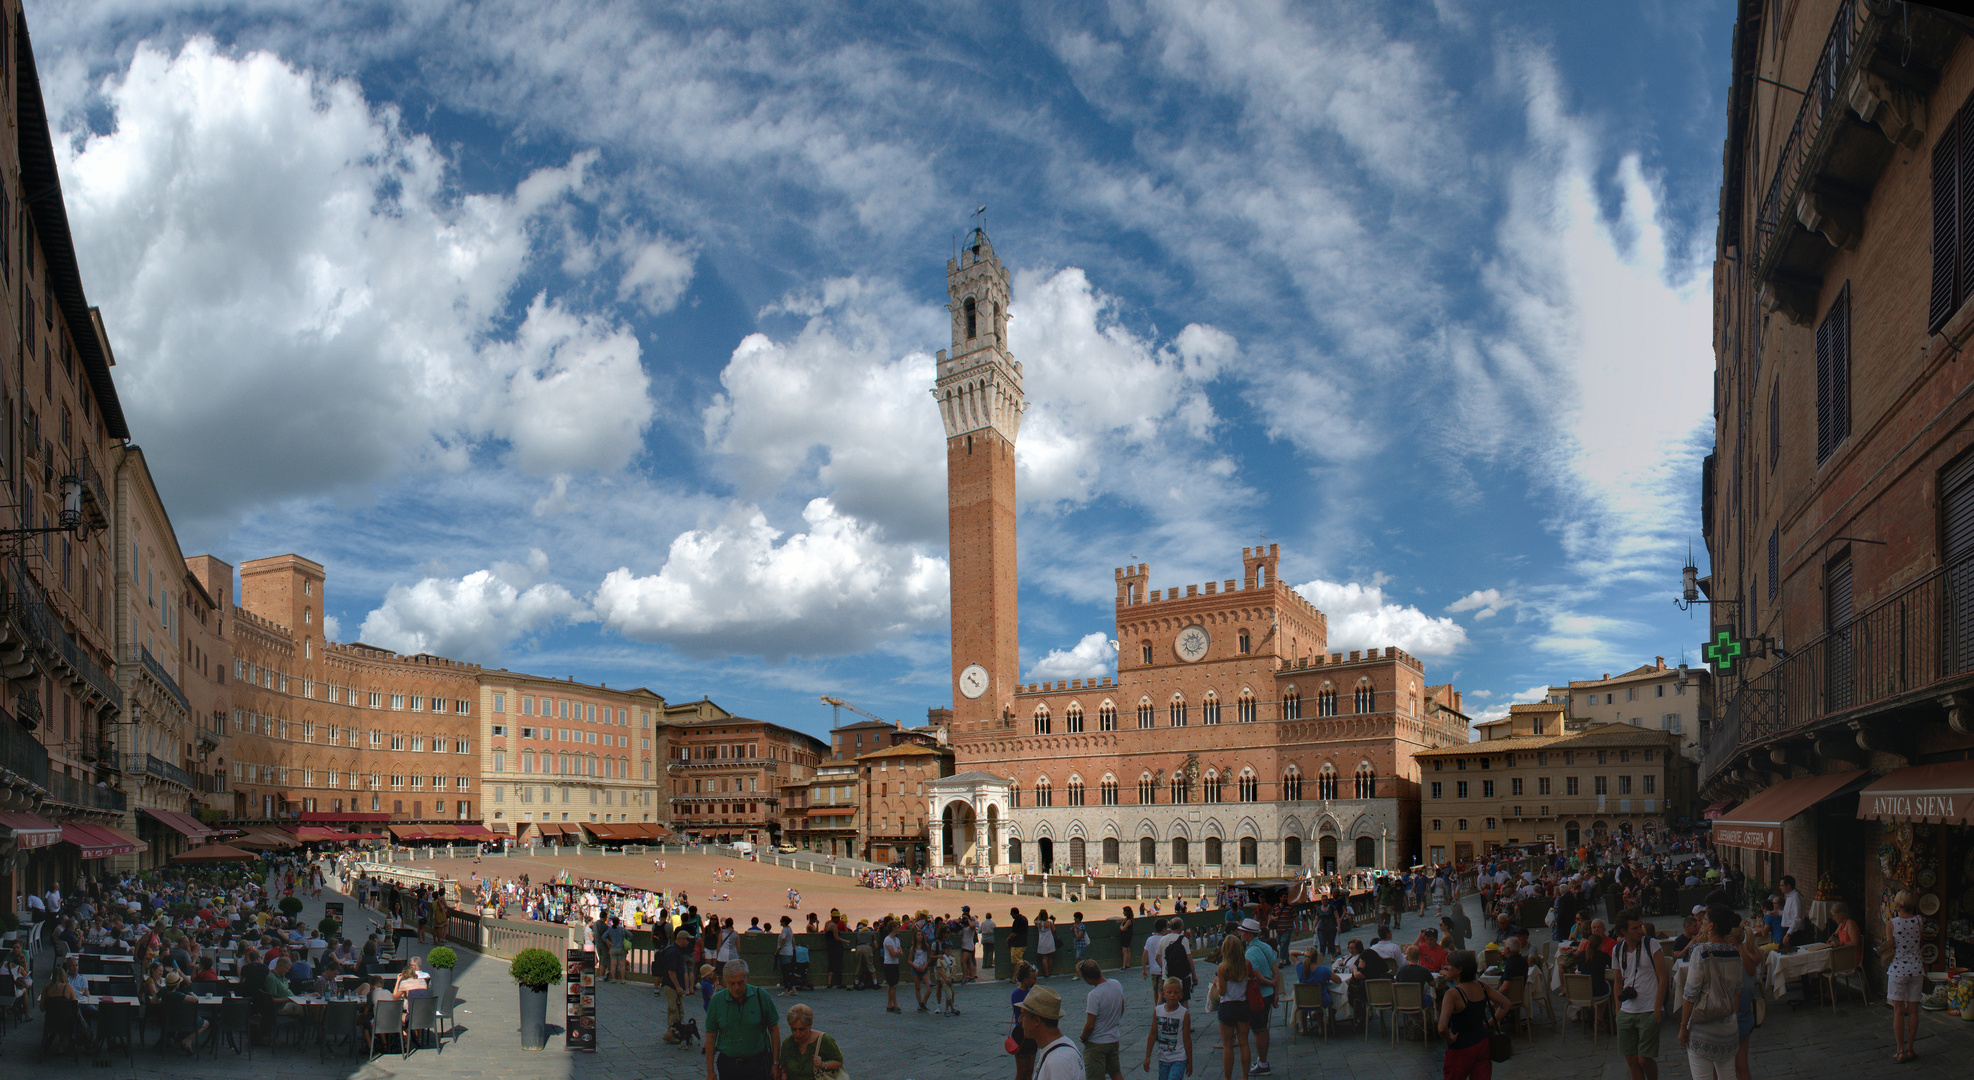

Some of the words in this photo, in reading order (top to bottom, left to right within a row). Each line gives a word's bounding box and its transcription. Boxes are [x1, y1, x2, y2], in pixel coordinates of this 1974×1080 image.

[1872, 797, 1911, 815] ANTICA
[1915, 796, 1955, 816] SIENA
[1743, 831, 1765, 845] OSTERIA
